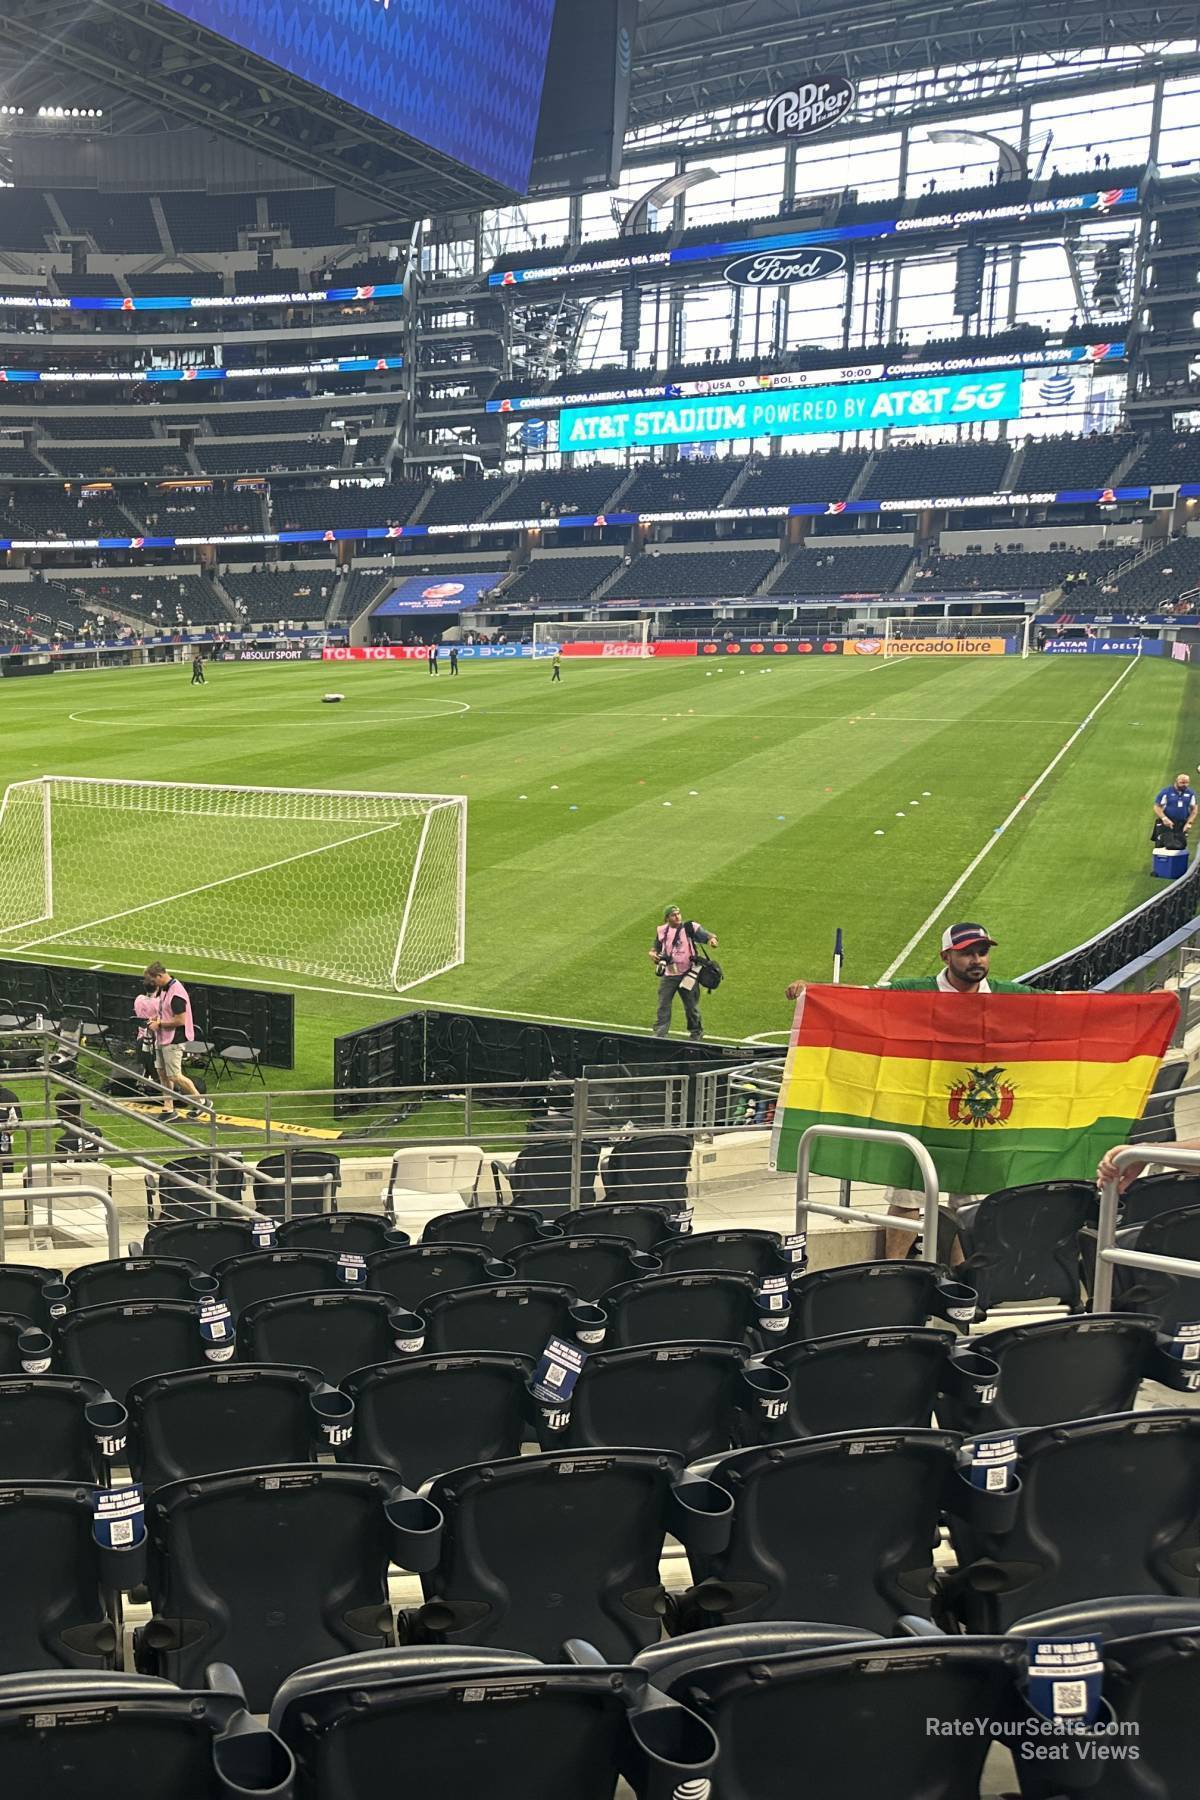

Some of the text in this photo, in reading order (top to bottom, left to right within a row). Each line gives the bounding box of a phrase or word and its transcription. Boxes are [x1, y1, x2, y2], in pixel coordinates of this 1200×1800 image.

[800, 83, 830, 109] Dr
[777, 91, 849, 133] Pepper
[896, 198, 1083, 230] CONMEBOL COPA AMERICA USA 2024
[569, 263, 589, 273] COPA
[589, 258, 630, 270] AMERICA
[632, 256, 648, 265] USA
[747, 252, 822, 283] Ford
[887, 362, 944, 373] CONMEBOL
[944, 359, 971, 369] COPA
[971, 355, 1021, 367] AMERICA
[1023, 352, 1043, 362] USA
[712, 368, 872, 390] USA 0 BOL 0 30:00
[566, 394, 586, 403] COPA
[586, 391, 625, 401] AMERICA
[627, 389, 643, 397] USA
[569, 382, 1007, 441] AT&T STADIUM POWERED BY AT&T 5G
[932, 498, 958, 508] COPA
[958, 495, 1008, 506] AMERICA
[1008, 494, 1028, 504] USA
[686, 511, 708, 520] COPA
[708, 509, 750, 519] AMERICA
[750, 508, 768, 516] USA
[886, 640, 991, 652] mercado libre
[1053, 640, 1087, 648] LATAM
[240, 651, 302, 660] ABSOLUT SPORT
[325, 648, 355, 659] TCL
[363, 647, 395, 659] TCL
[403, 646, 428, 659] TC
